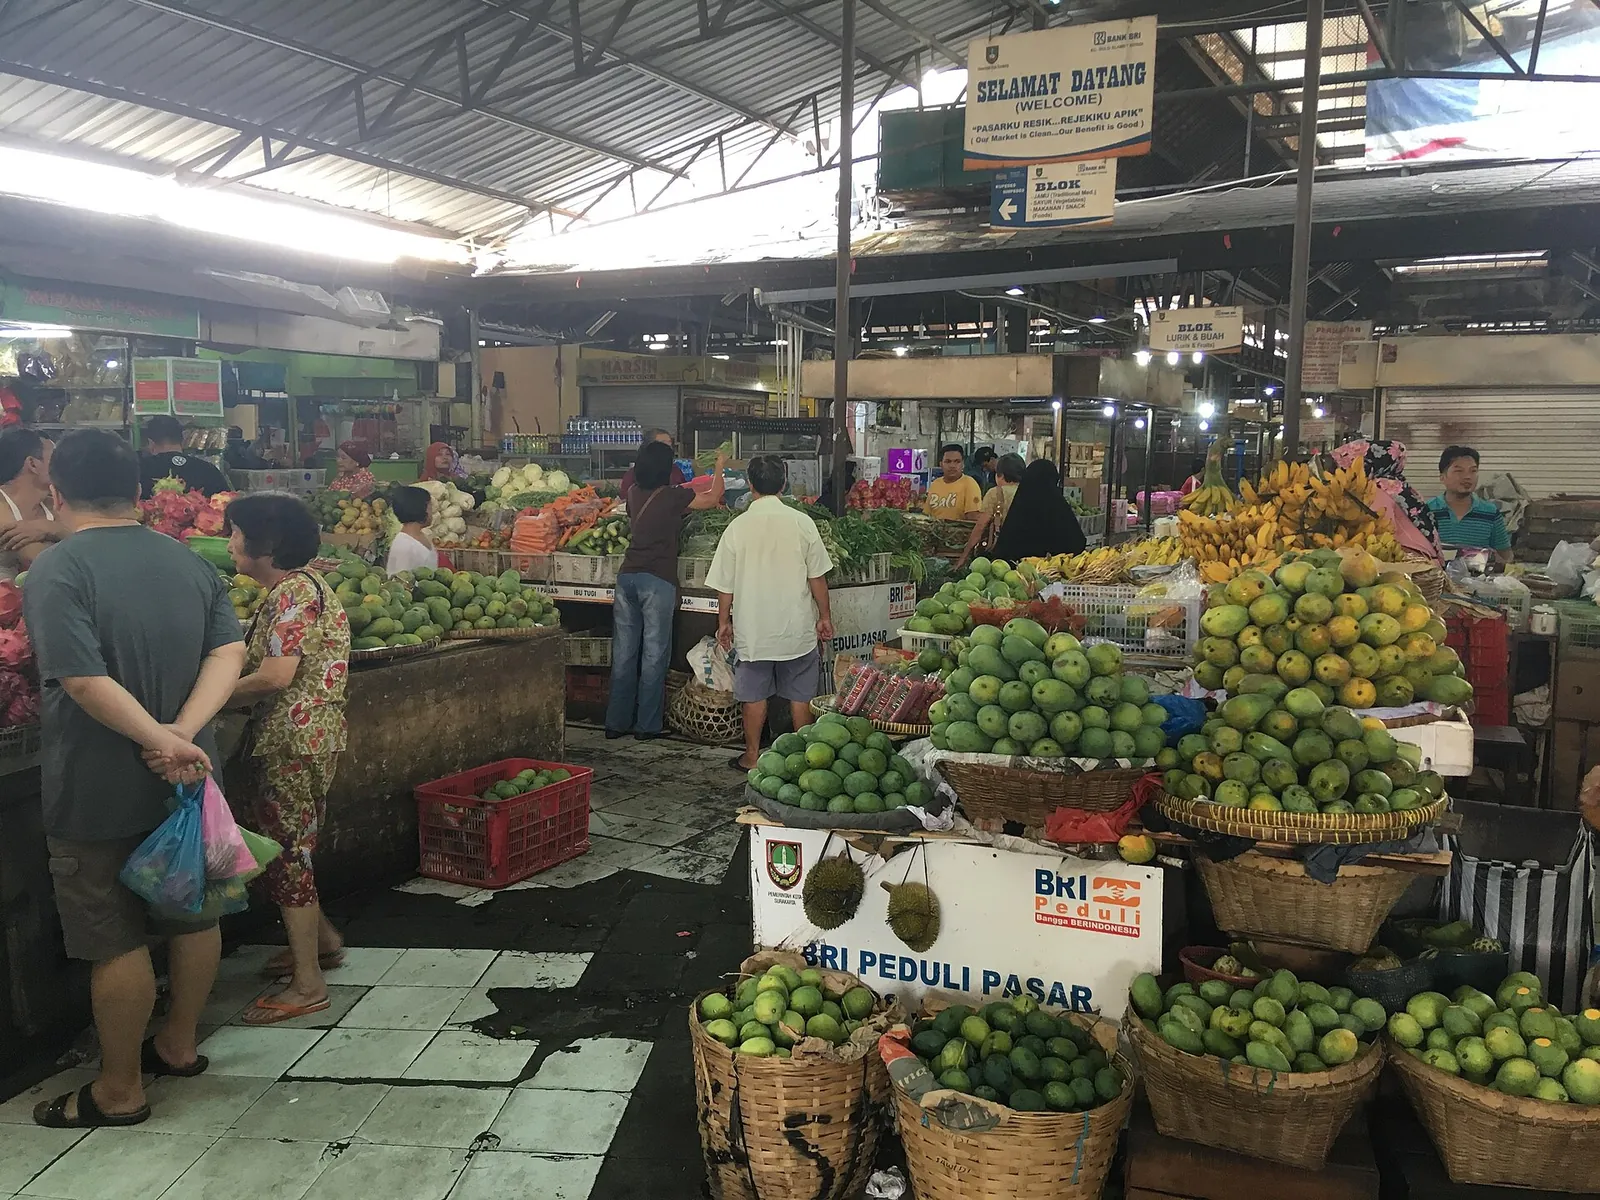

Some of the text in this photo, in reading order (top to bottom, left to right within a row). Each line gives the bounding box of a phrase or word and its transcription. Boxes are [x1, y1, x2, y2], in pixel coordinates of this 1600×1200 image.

[1107, 32, 1141, 43] BANK BRI
[977, 62, 1146, 102] SELAMAT DATANG
[1016, 94, 1102, 114] (WELCOME)
[976, 136, 989, 144] Our
[991, 133, 1018, 142] Market
[1075, 124, 1105, 134] Benefit
[1116, 121, 1139, 130] Good
[1034, 179, 1081, 192] BLOK
[1050, 190, 1080, 199] (Traditional
[1053, 197, 1086, 205] (Vegetables)
[66, 311, 92, 322] Pasar
[1178, 323, 1213, 332] BLOK
[1166, 333, 1190, 342] LURIK
[1200, 332, 1224, 340] BUAH
[929, 493, 957, 508] Bali
[890, 586, 903, 603] BRI
[890, 600, 915, 613] Peduli
[832, 630, 888, 652] EDULI PASAR
[1035, 868, 1087, 901] BRI
[1035, 896, 1140, 925] Peduli
[1036, 914, 1139, 936] Bangga BERINDONESIA
[803, 942, 1094, 1013] BRI PEDULI PASAR
